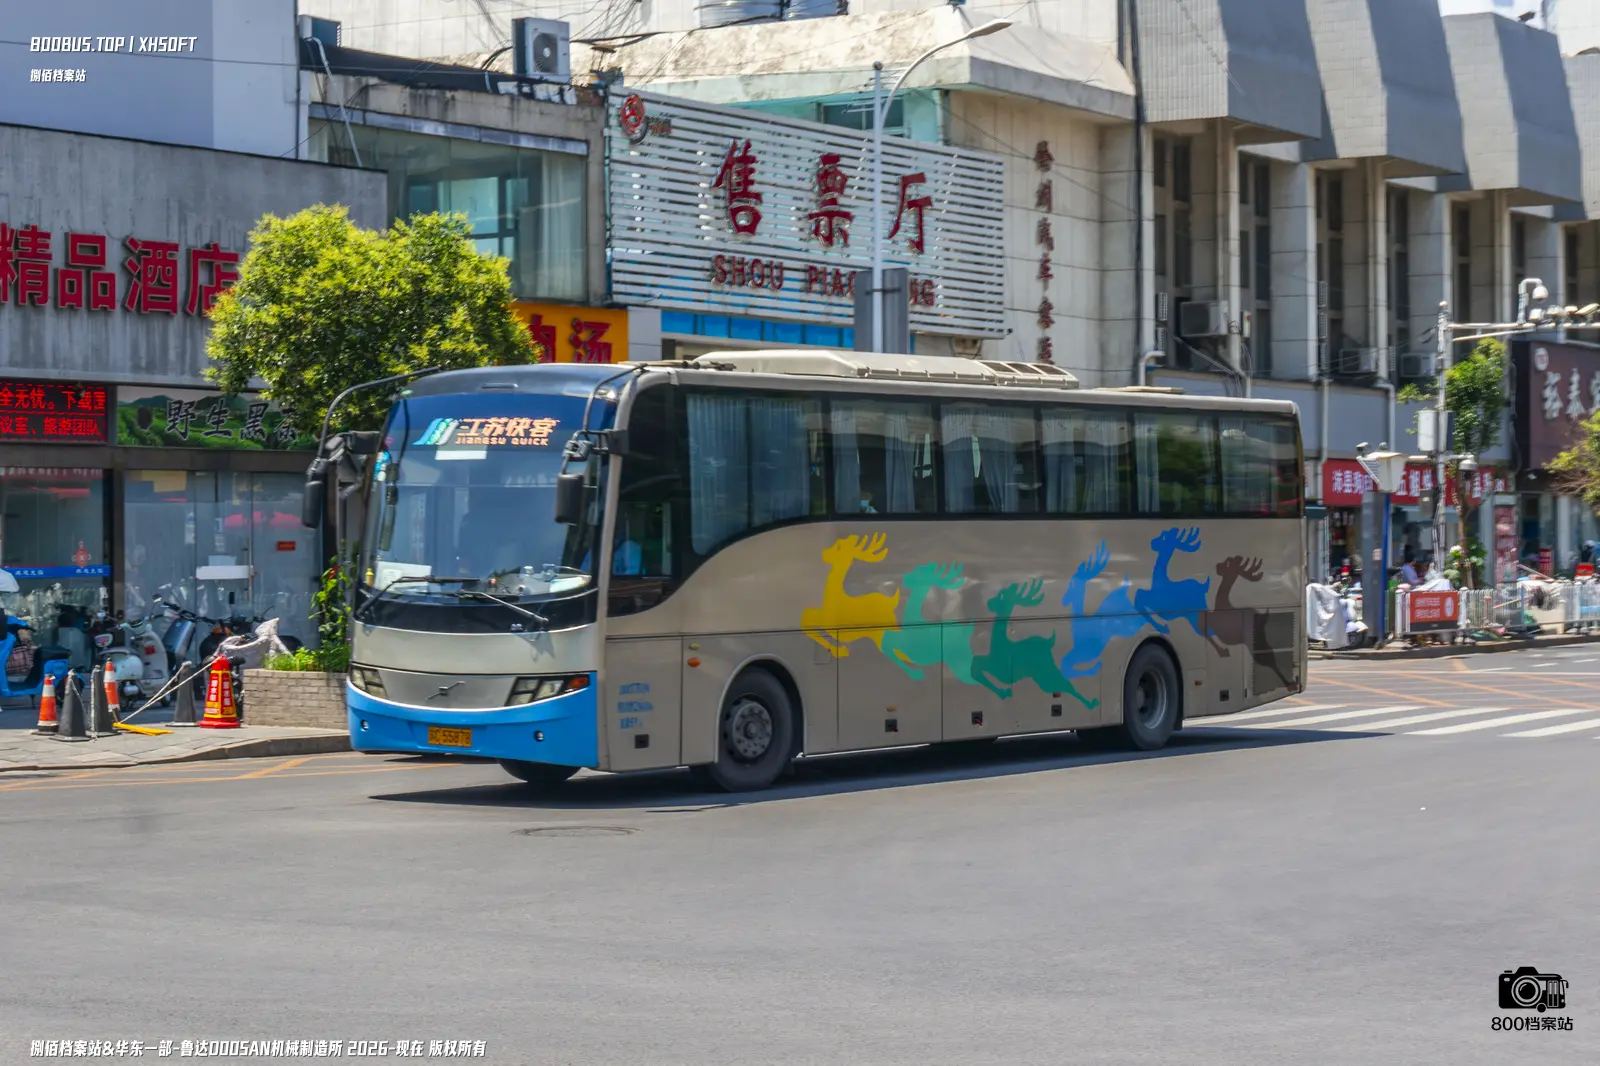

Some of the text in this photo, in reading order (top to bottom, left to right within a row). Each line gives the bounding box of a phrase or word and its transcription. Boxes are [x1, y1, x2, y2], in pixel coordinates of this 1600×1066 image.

[712, 138, 934, 255] 售票厅
[0, 222, 240, 317] 精品酒店
[712, 254, 784, 290] SHOU
[456, 416, 560, 438] 江苏快客
[510, 437, 550, 447] QUICK
